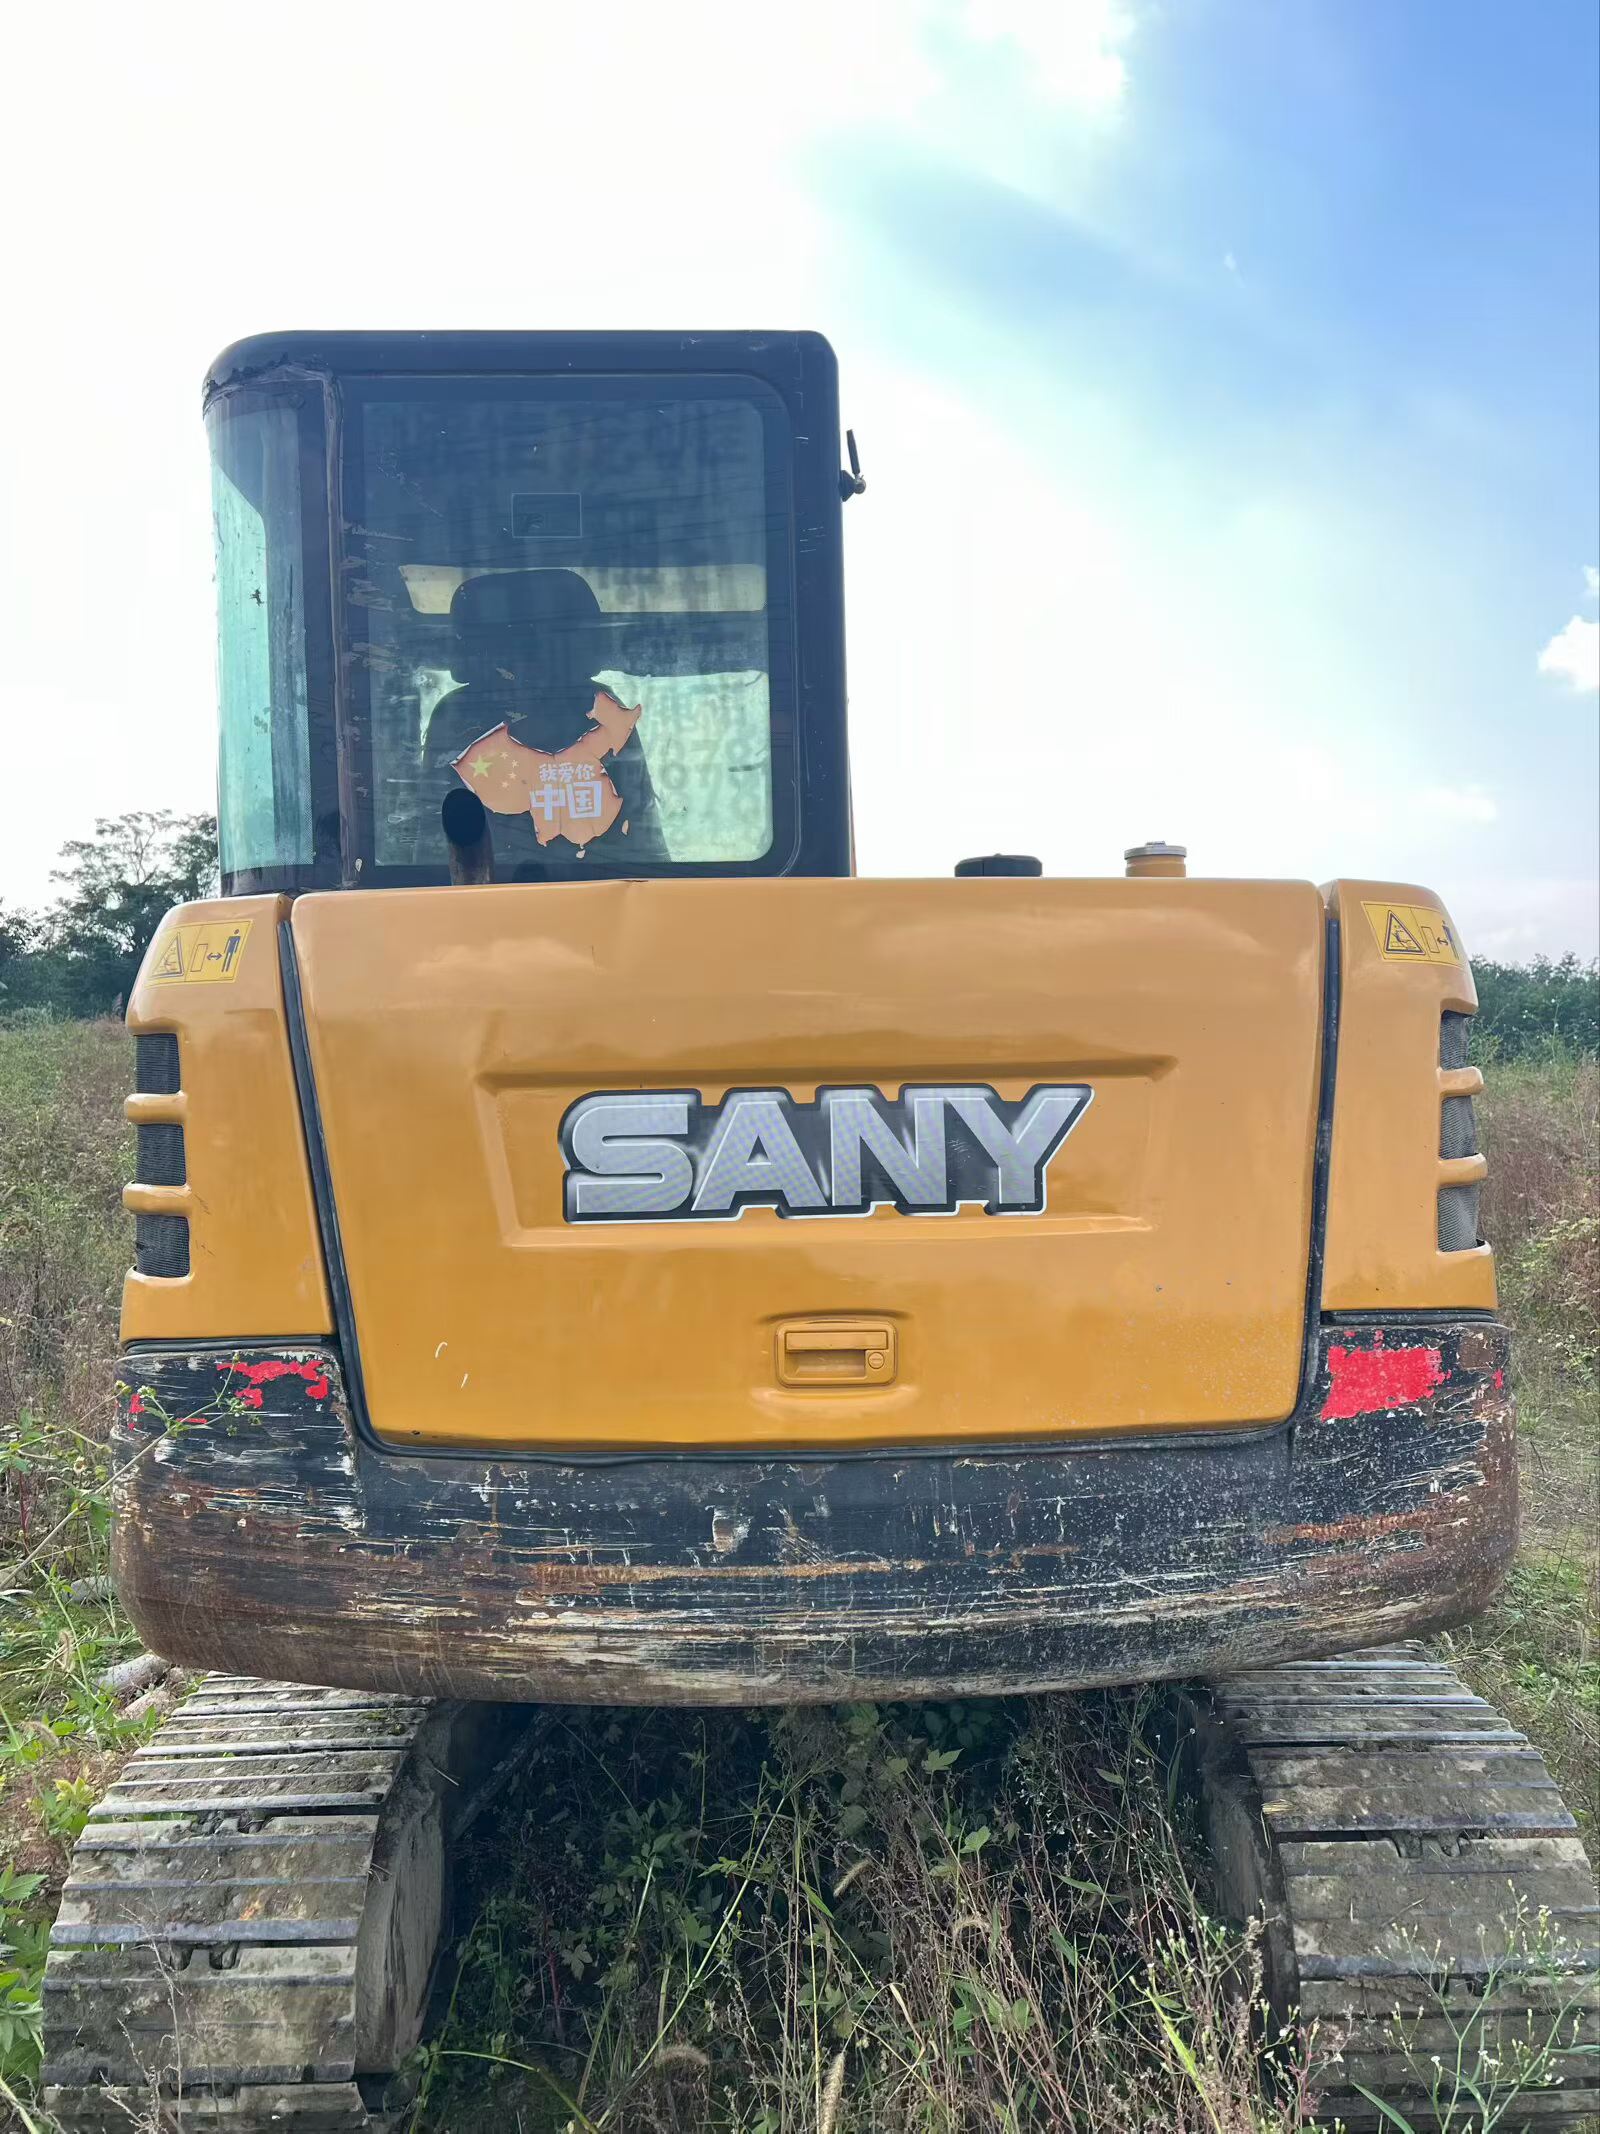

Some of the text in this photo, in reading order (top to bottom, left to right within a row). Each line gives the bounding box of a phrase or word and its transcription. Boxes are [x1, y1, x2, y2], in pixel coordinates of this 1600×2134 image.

[539, 762, 595, 783] 我爱你
[529, 780, 603, 821] 中国
[565, 1091, 1088, 1218] SANY
